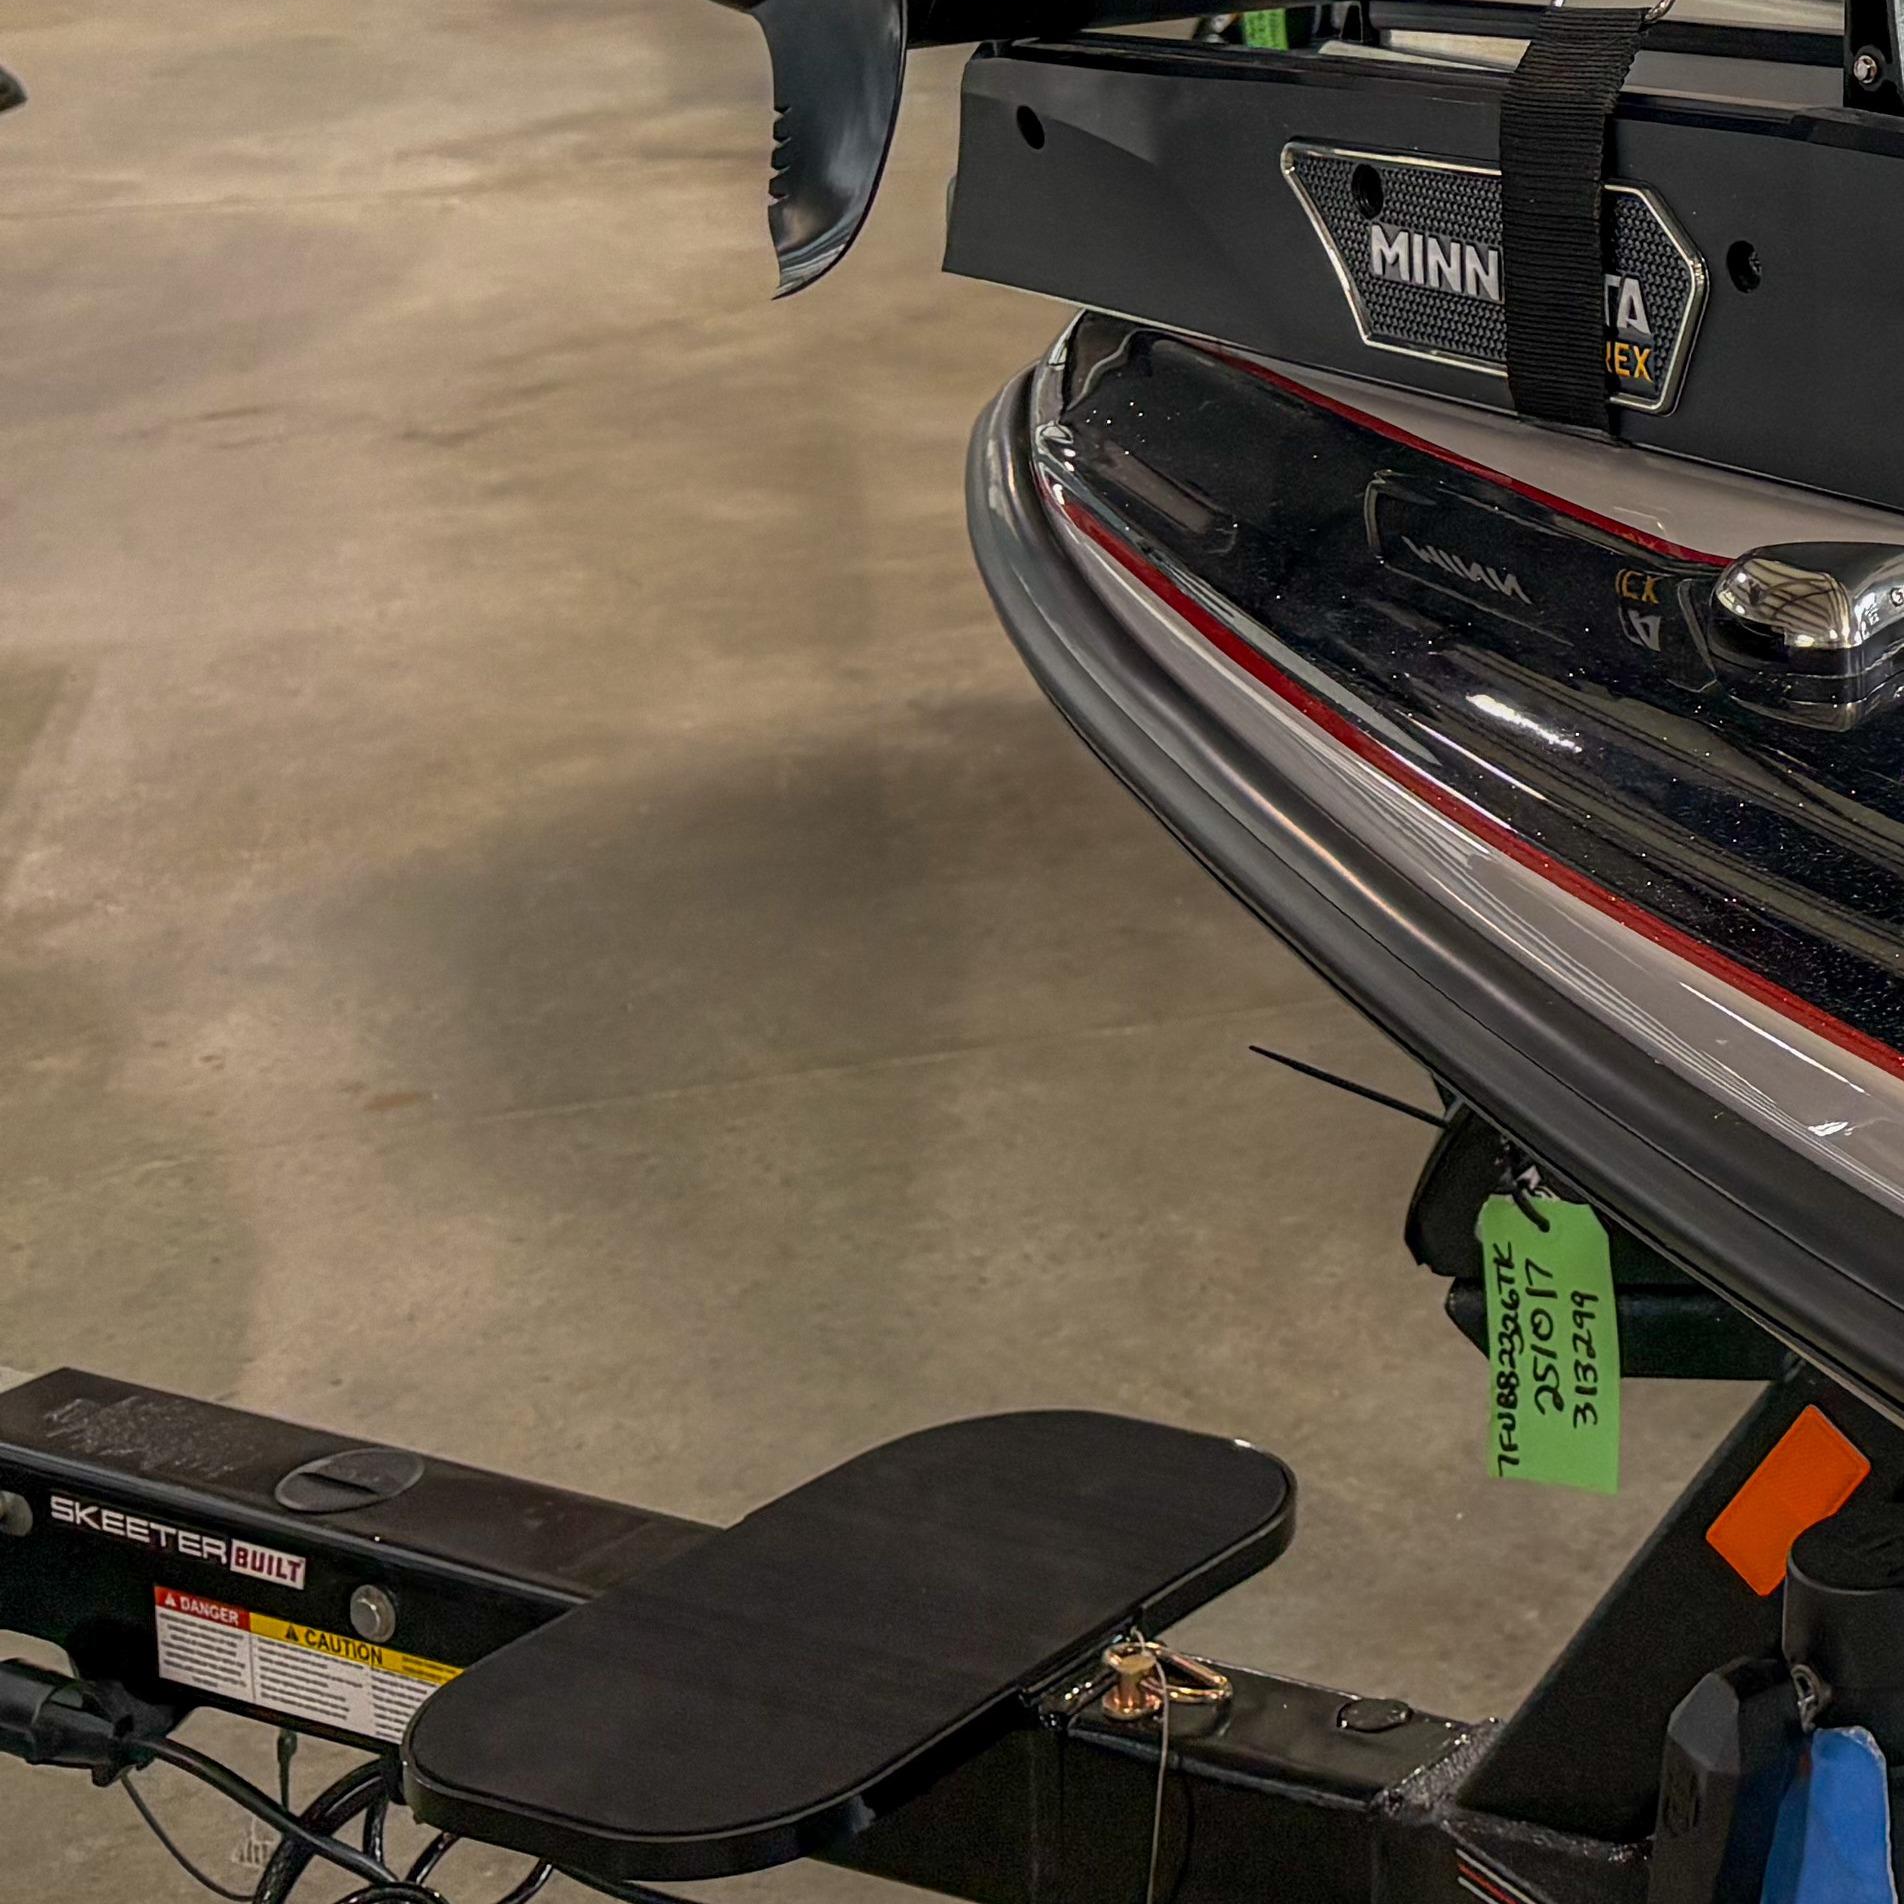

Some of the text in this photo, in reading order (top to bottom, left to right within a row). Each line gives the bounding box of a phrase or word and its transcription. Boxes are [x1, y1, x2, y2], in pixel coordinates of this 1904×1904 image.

[1370, 224, 1501, 302] MINN
[1525, 1258, 1564, 1416] 251017
[1570, 1290, 1599, 1430] 313299
[50, 1495, 304, 1583] SKEETER BUILT
[180, 1596, 239, 1626] DANGER
[304, 1631, 383, 1666] CAUTION
